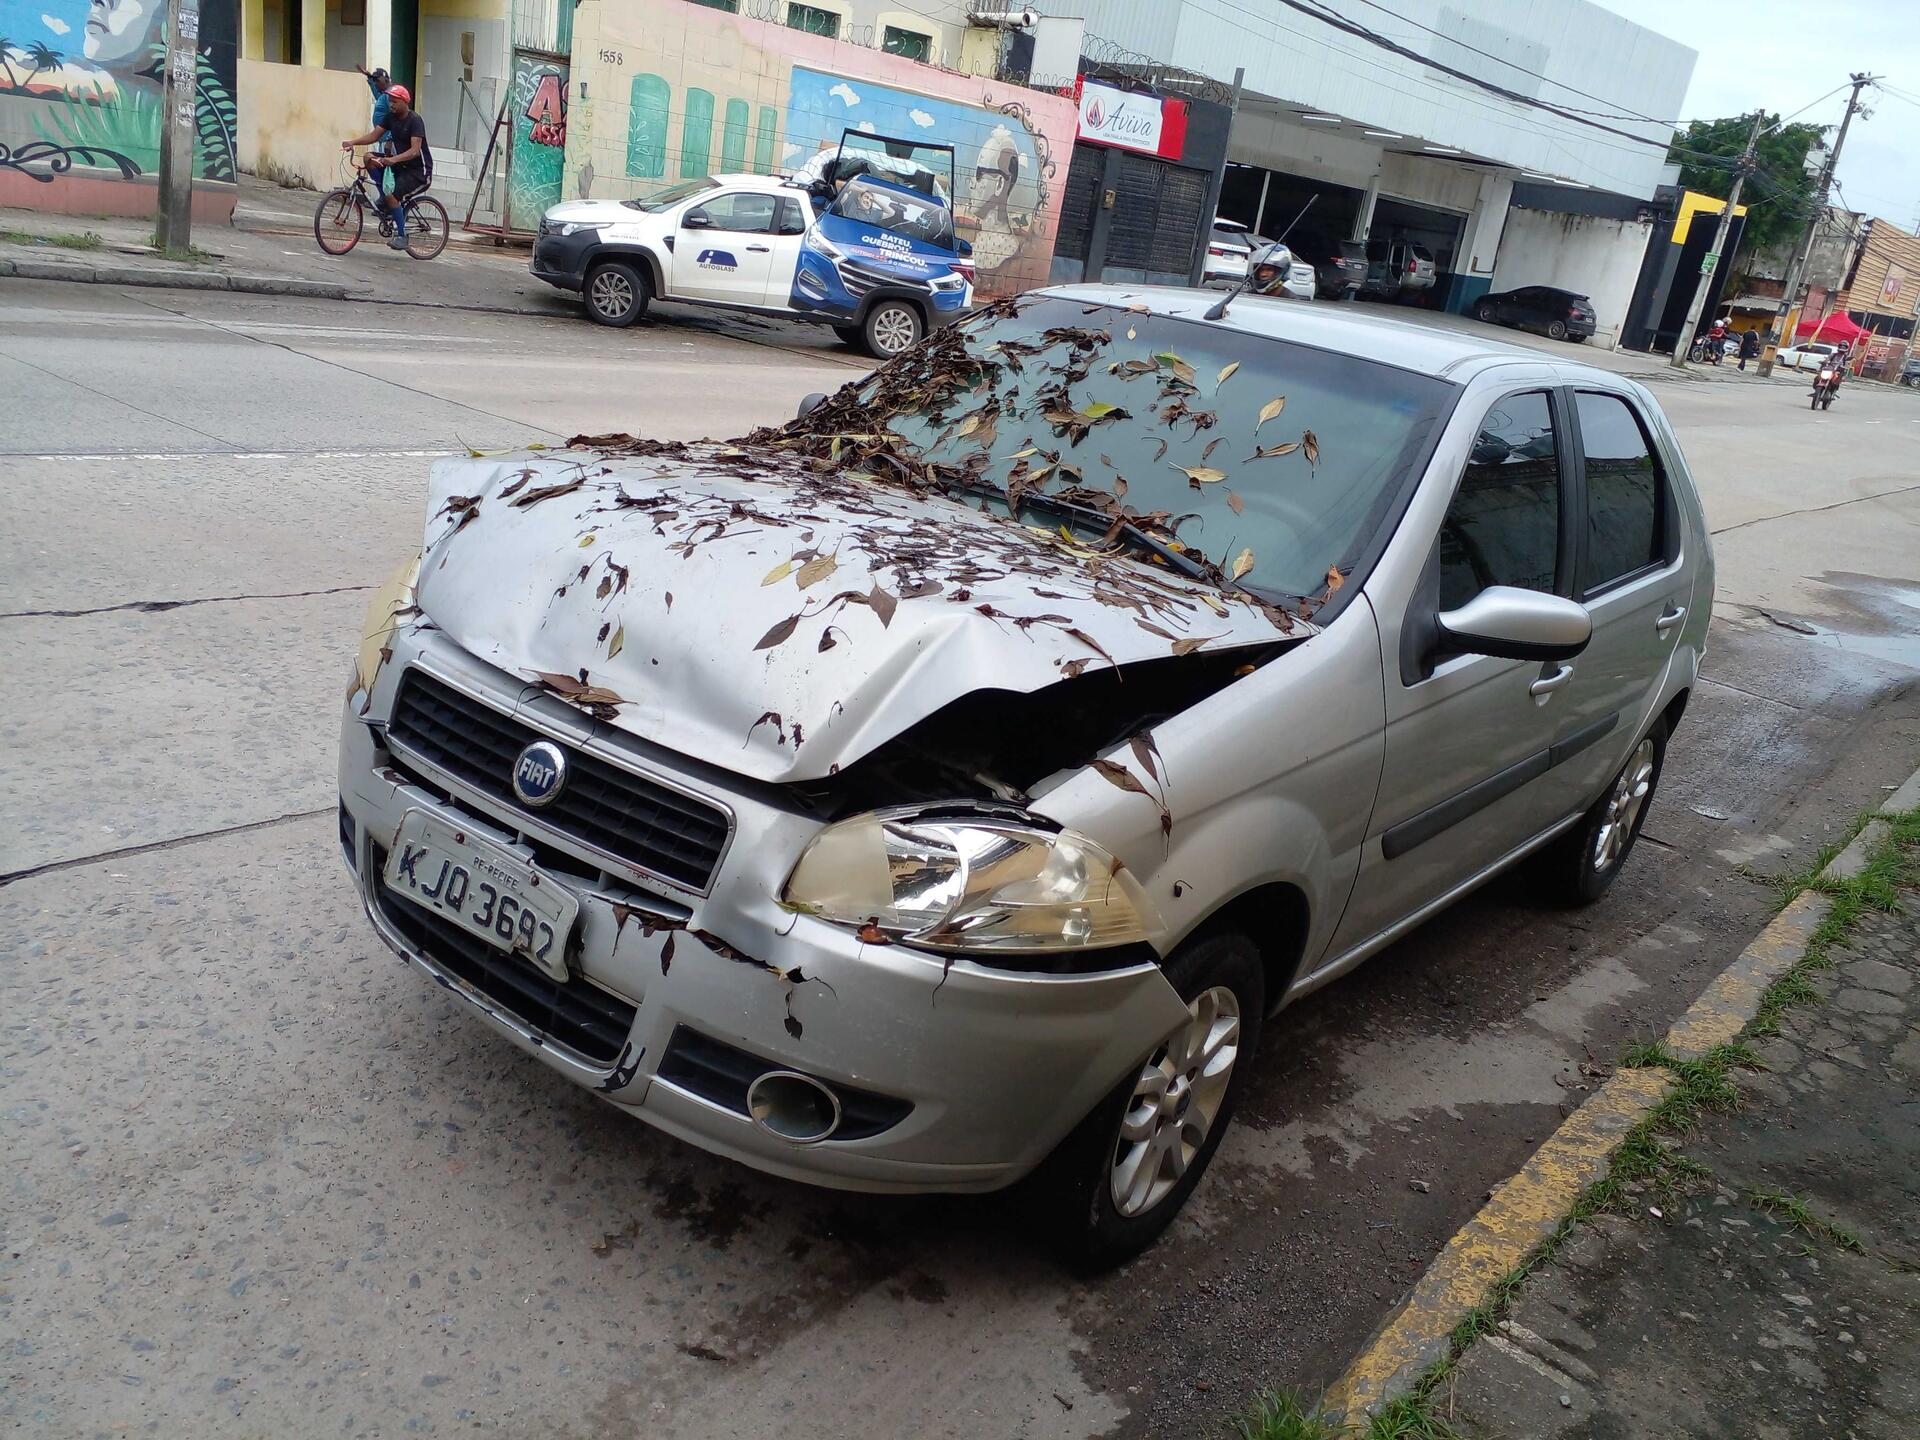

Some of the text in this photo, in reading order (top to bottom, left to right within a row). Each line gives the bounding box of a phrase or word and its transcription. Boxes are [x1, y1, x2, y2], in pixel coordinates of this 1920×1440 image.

[599, 48, 623, 66] 1558
[1096, 102, 1153, 136] Aviva
[880, 233, 912, 249] BATEU,
[699, 263, 735, 273] AUTOGLASS
[879, 248, 928, 268] TRINCOU.
[518, 757, 556, 789] FIAT
[473, 856, 520, 891] PE-RECIFE
